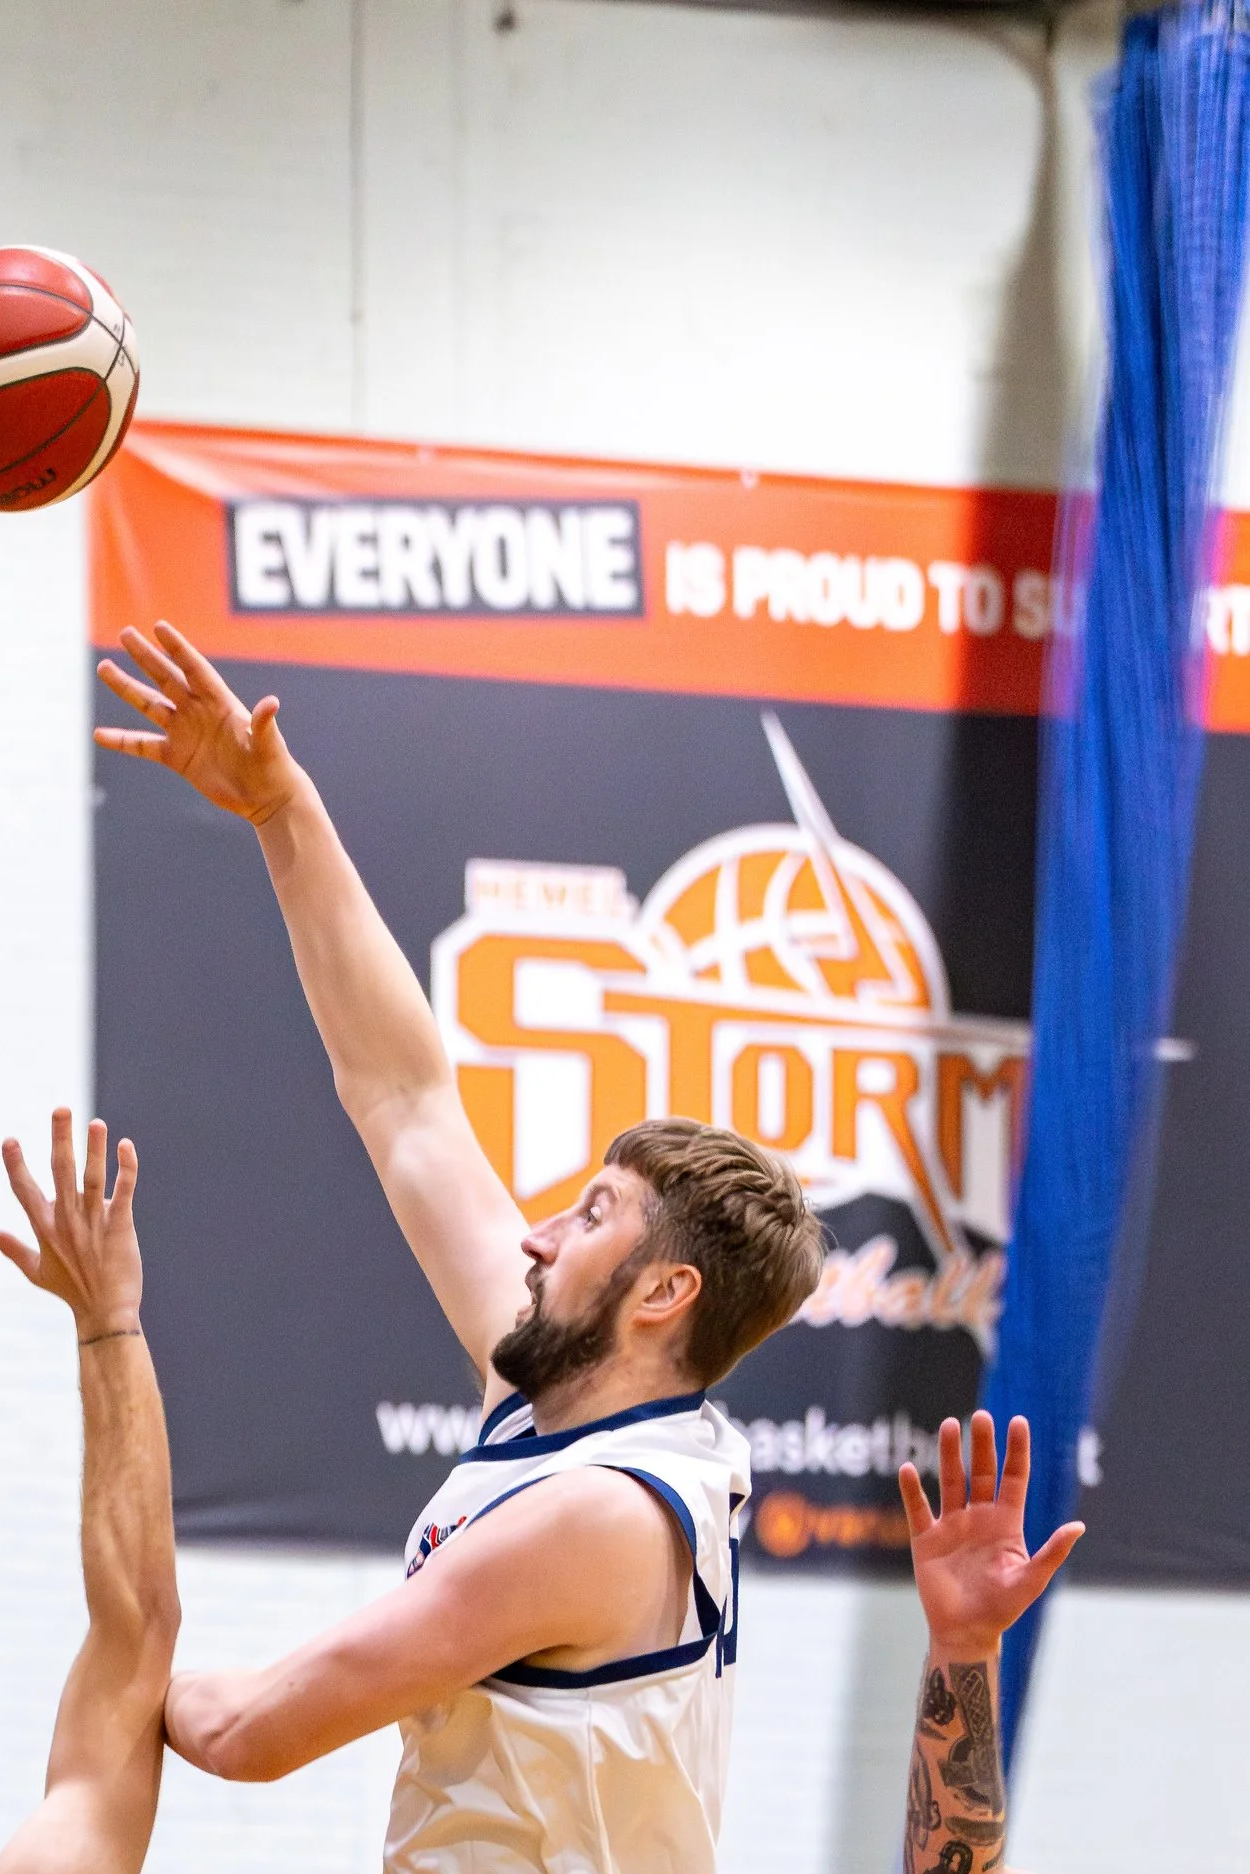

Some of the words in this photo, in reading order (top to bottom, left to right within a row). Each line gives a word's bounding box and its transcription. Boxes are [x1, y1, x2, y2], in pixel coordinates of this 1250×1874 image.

[234, 503, 639, 610] EVERYONE
[663, 540, 726, 617] IS
[731, 545, 926, 633] PROUD
[928, 560, 1004, 637] TO
[456, 932, 1028, 1252] STORM
